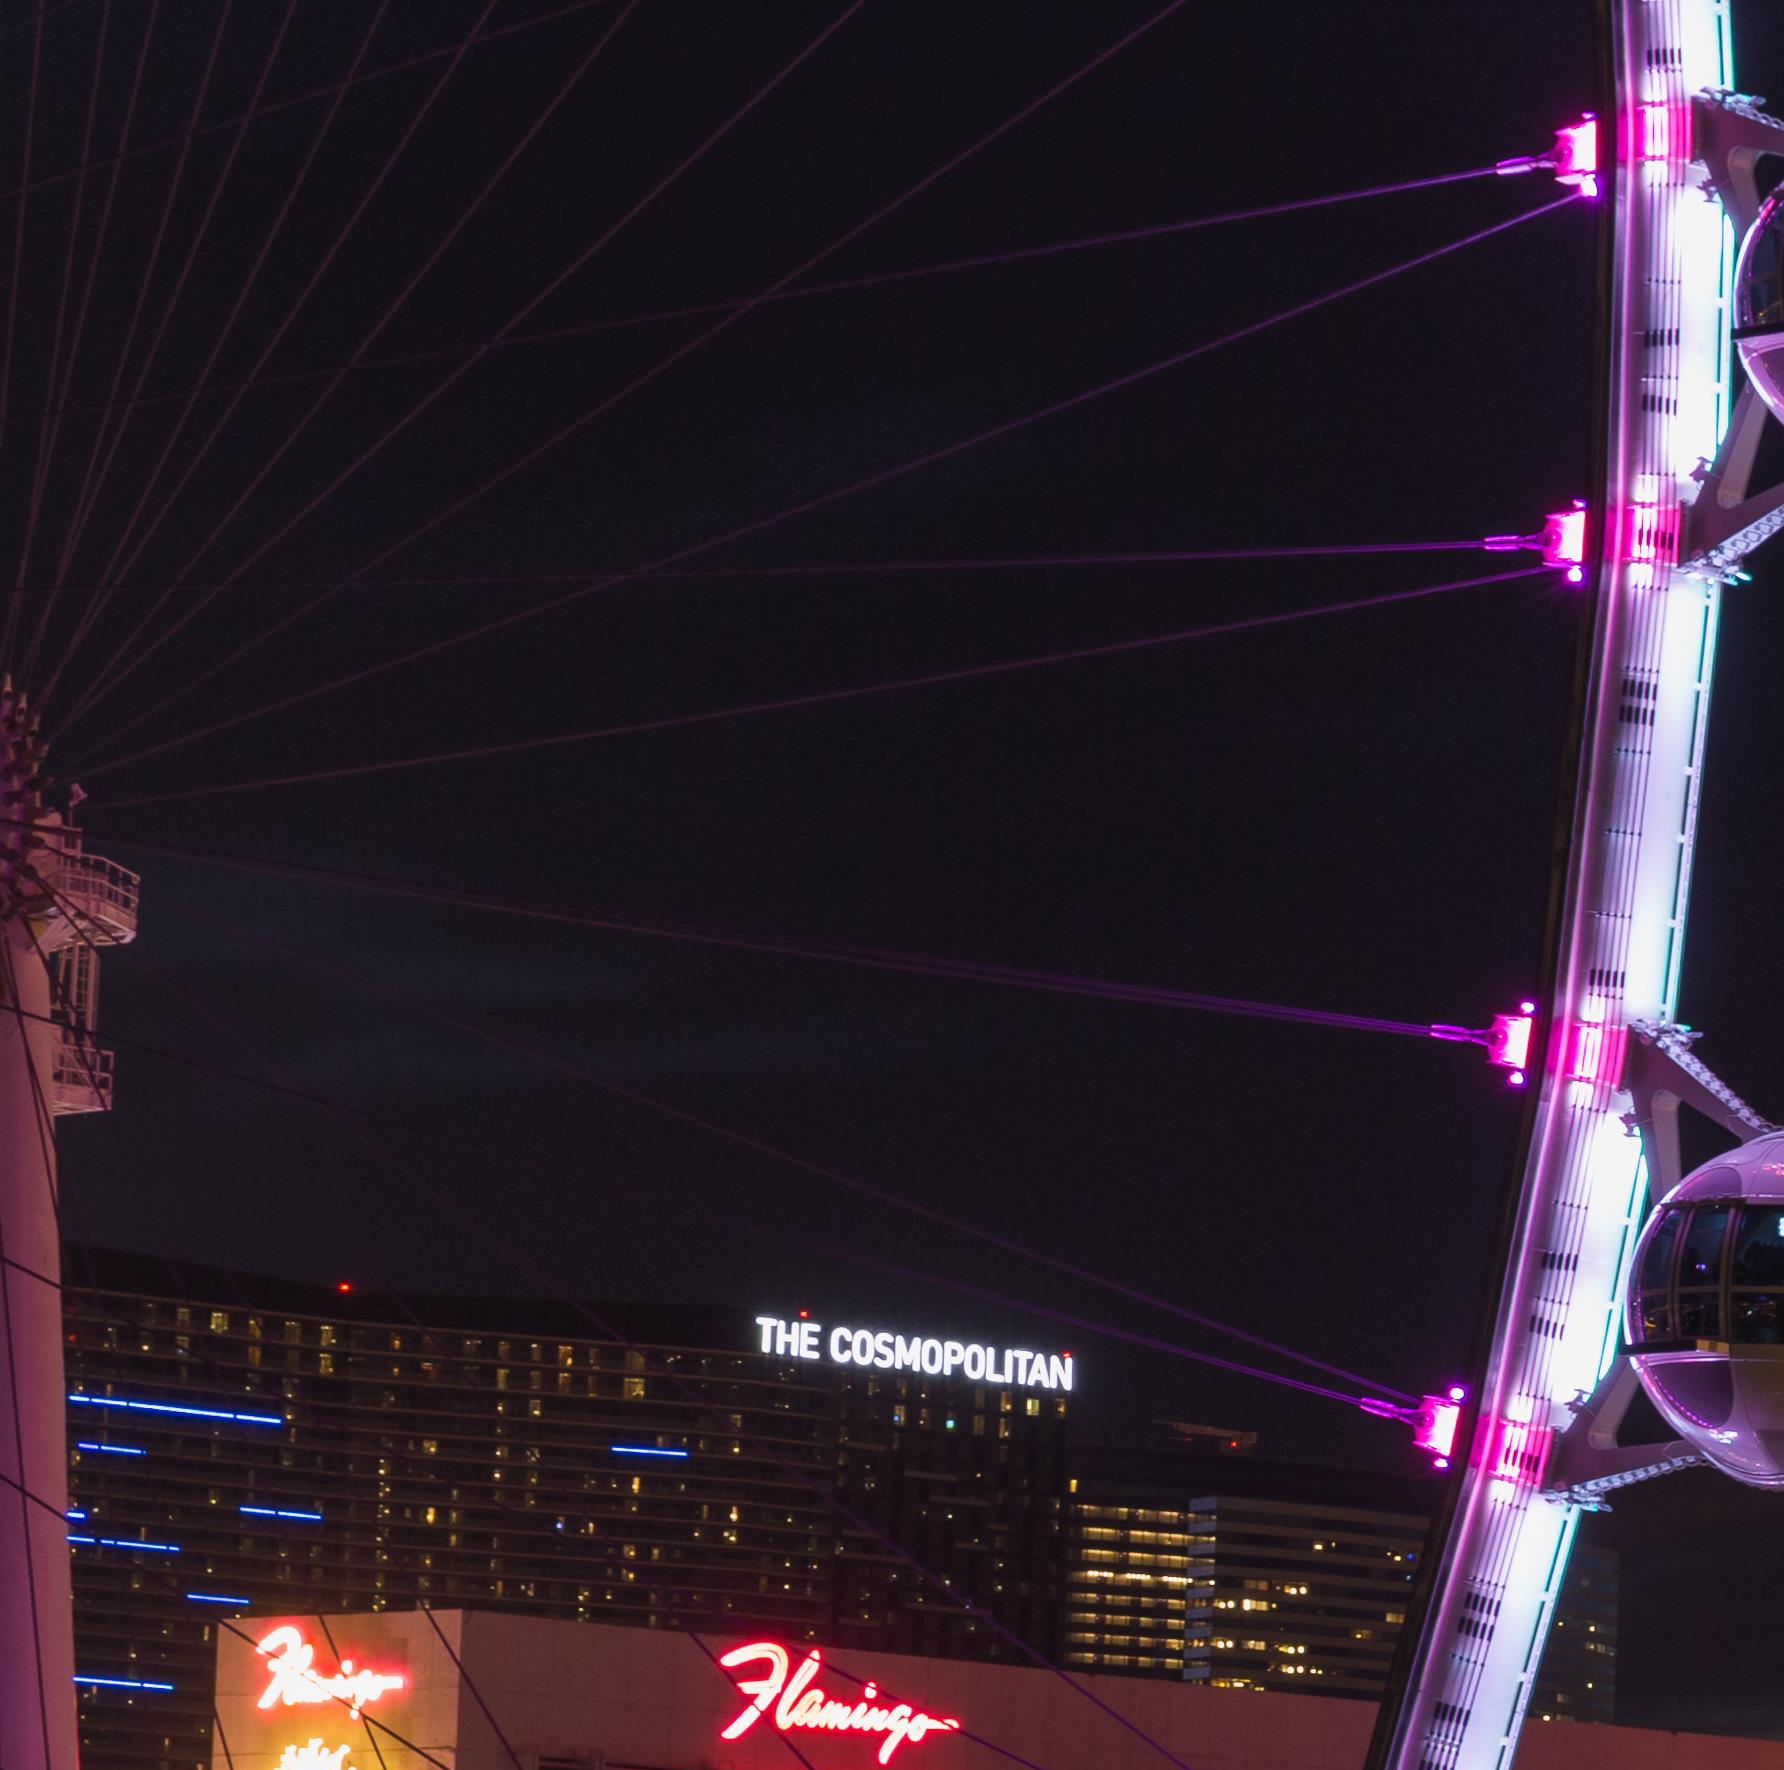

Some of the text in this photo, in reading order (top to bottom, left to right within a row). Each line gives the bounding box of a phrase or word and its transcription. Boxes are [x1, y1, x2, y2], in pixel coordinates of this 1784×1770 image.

[755, 1316, 1074, 1392] THE COSMOPOLITAN
[719, 1642, 960, 1765] Flamingo
